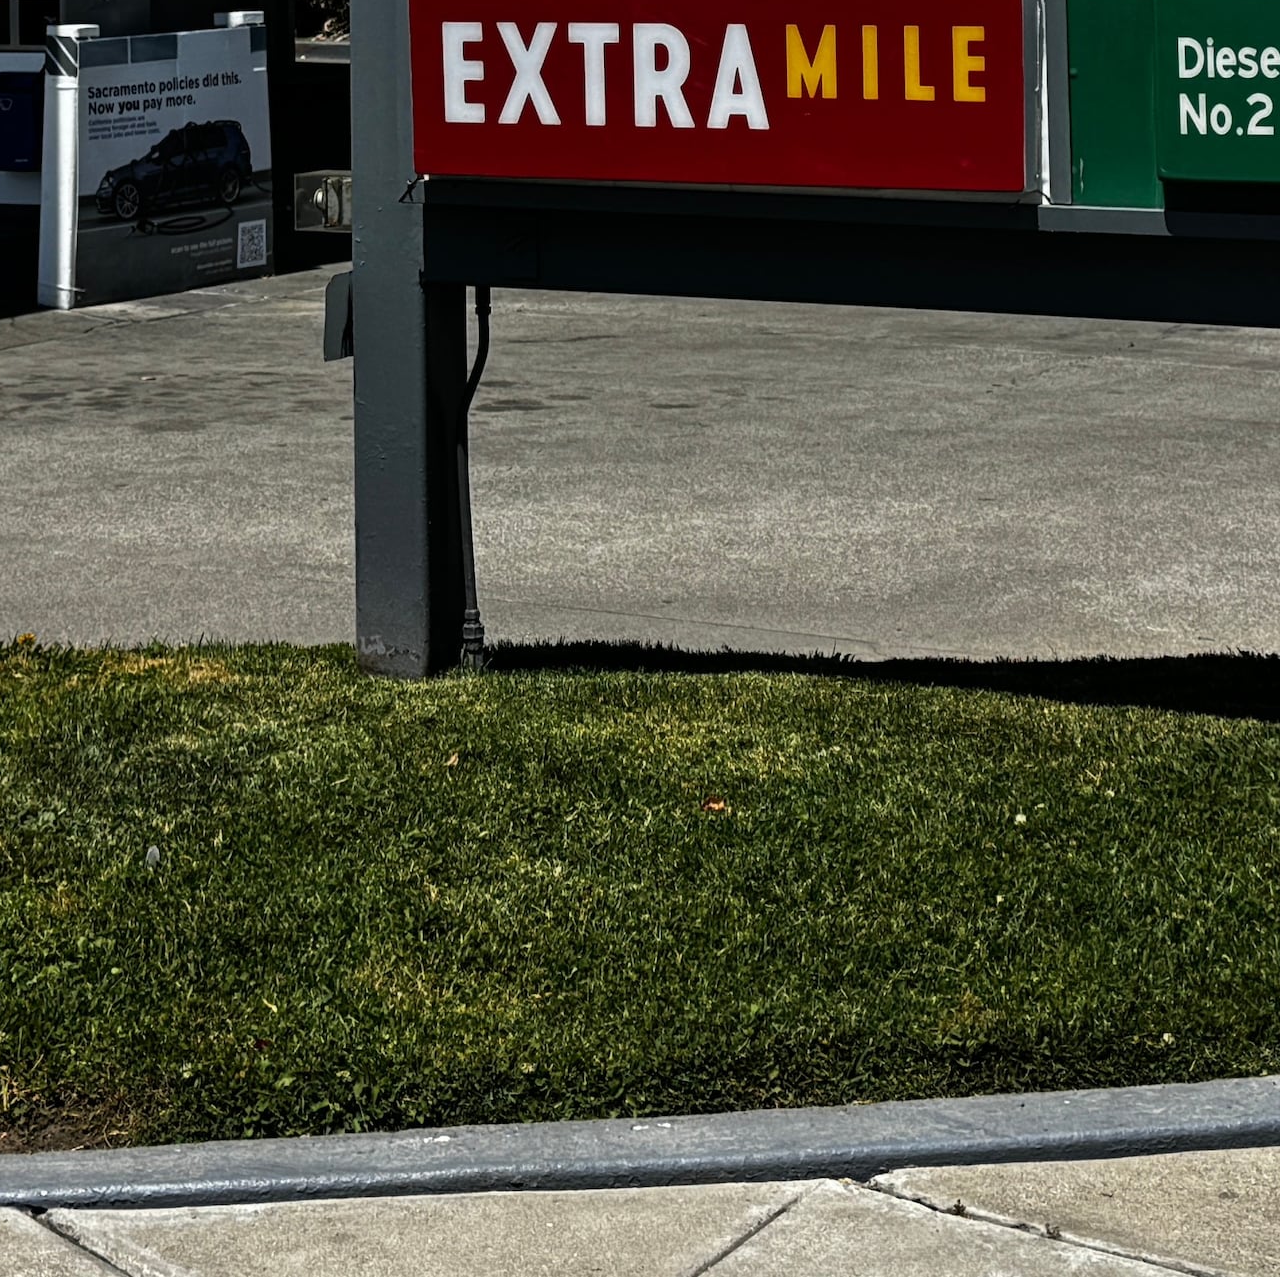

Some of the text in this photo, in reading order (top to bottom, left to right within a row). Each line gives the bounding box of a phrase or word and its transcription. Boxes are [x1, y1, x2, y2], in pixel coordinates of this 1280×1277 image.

[88, 71, 242, 99] Sacramento policies did this.
[88, 94, 196, 116] Now you pay more.
[1178, 93, 1275, 136] No.2
